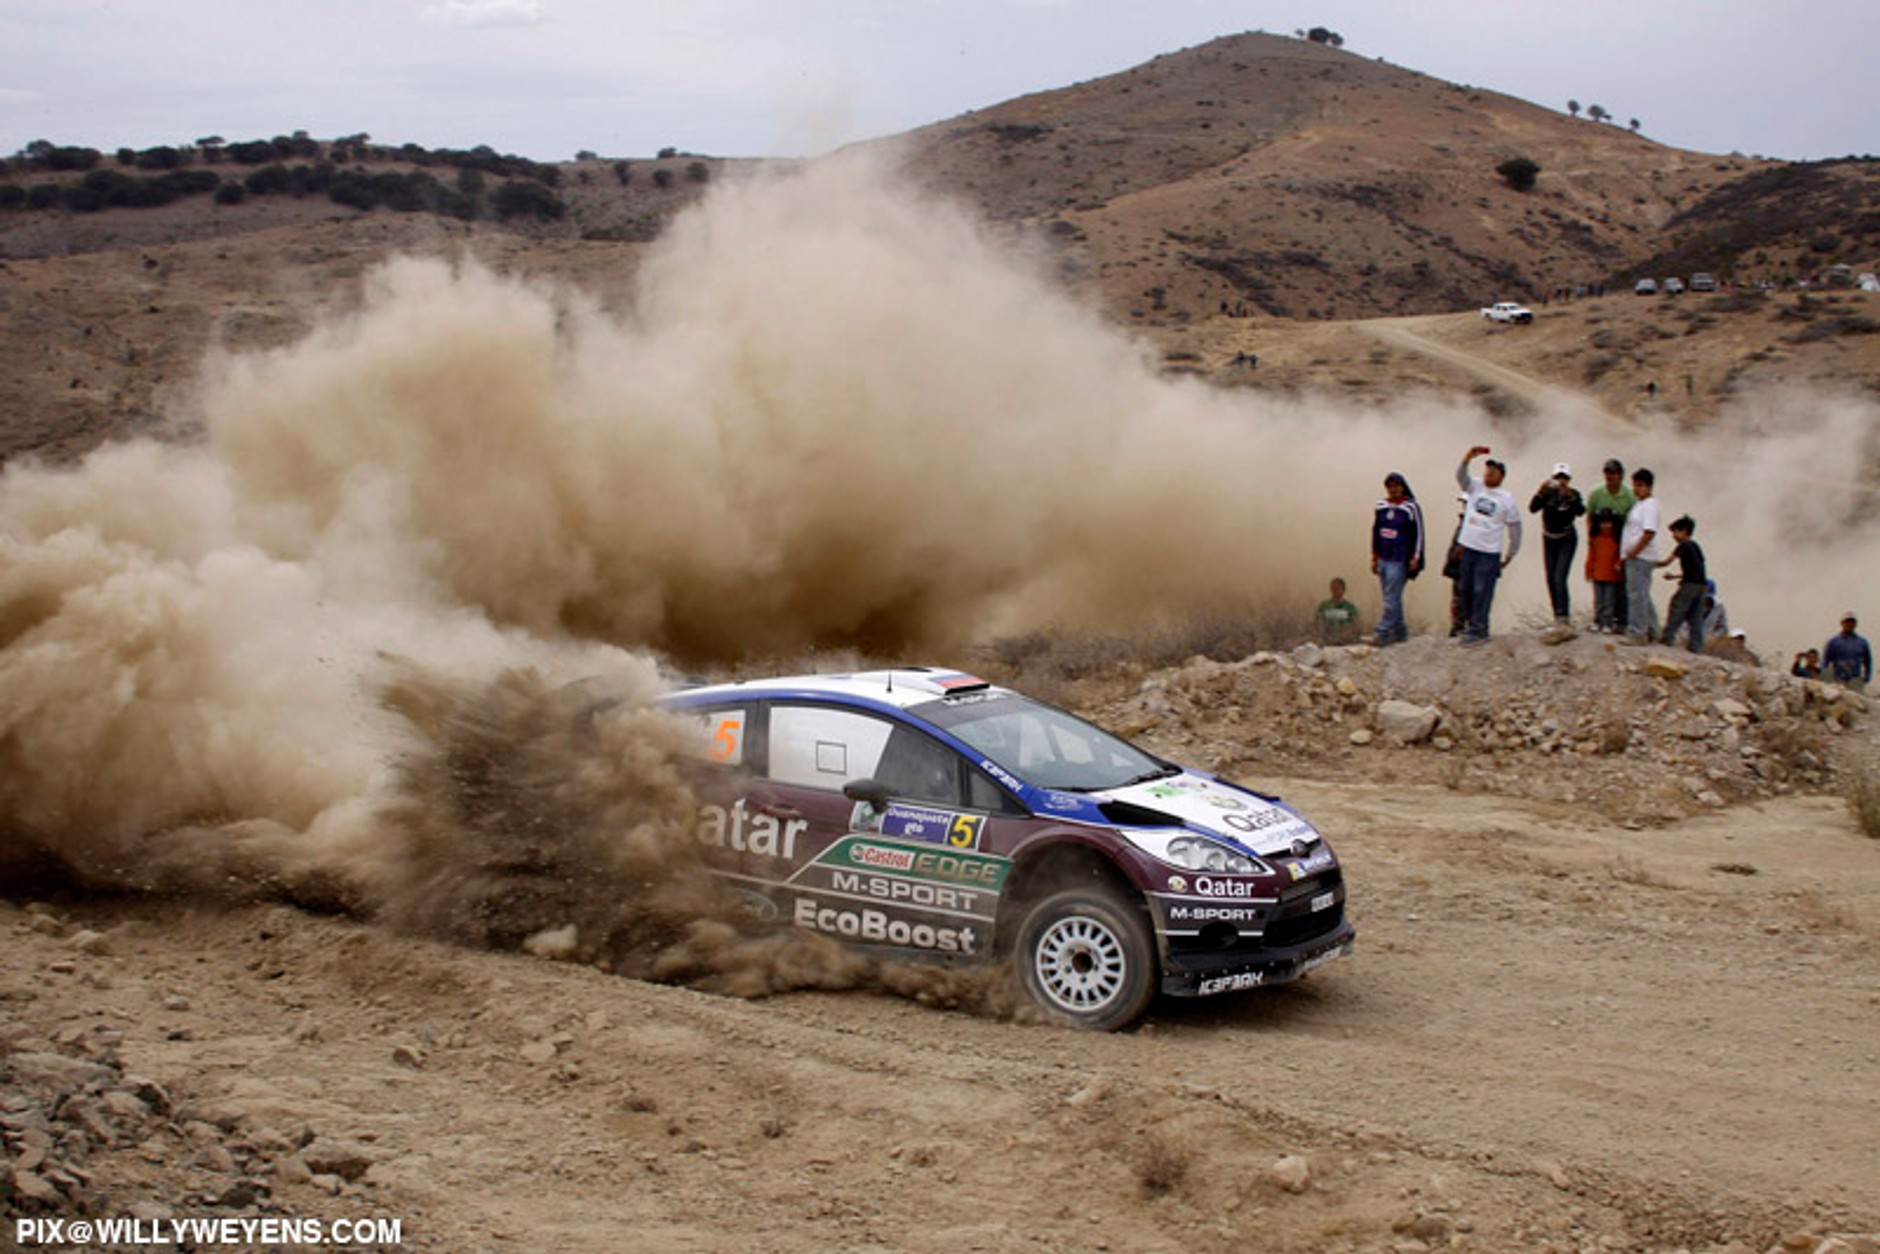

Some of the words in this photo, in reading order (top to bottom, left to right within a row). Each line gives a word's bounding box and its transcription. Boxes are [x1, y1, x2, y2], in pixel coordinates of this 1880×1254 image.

[709, 720, 741, 761] 5
[697, 798, 808, 859] atar
[950, 815, 977, 847] 5
[863, 848, 911, 869] Castrol
[915, 853, 1001, 883] EDGE
[832, 870, 978, 910] M-SPORT
[1195, 877, 1254, 897] Qatar
[794, 897, 976, 955] EcoBoost
[1170, 907, 1256, 921] M-SPORT
